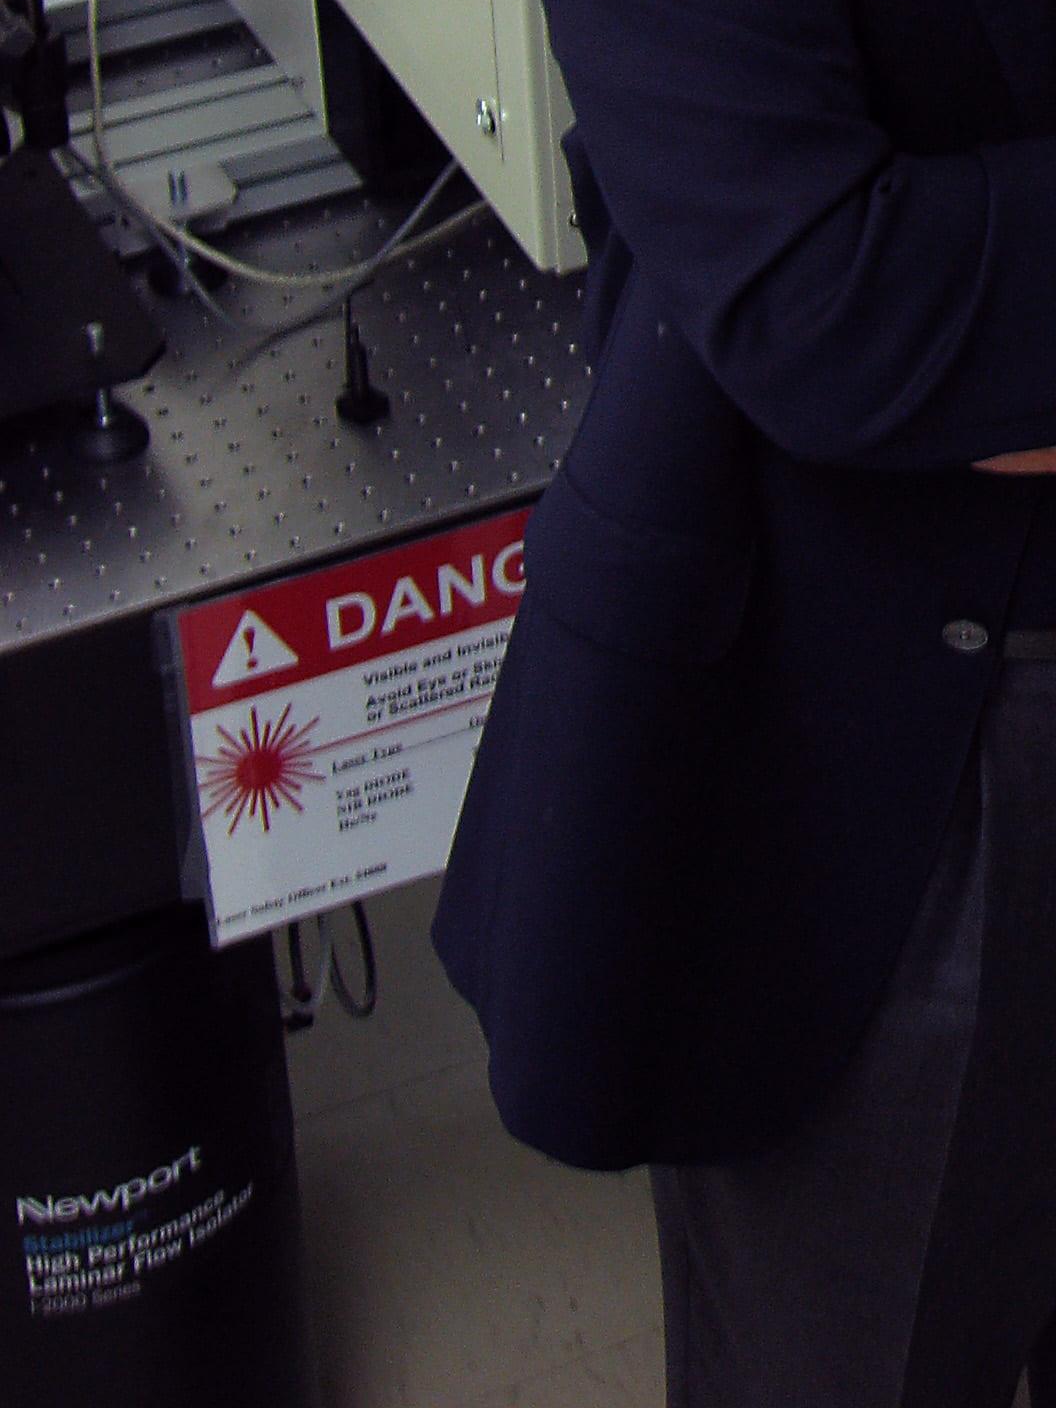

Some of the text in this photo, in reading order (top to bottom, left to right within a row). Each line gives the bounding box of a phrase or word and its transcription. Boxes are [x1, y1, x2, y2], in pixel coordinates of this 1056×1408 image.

[363, 662, 417, 686] Visible
[423, 650, 452, 668] and
[366, 685, 412, 708] Avoid
[417, 674, 446, 692] Eye
[452, 668, 468, 681] or
[367, 709, 382, 722] or
[388, 682, 465, 714] Scattered
[16, 1145, 201, 1226] Newport
[26, 1189, 225, 1276] High Performance
[28, 1261, 125, 1293] Laminar
[133, 1237, 183, 1274] Flow
